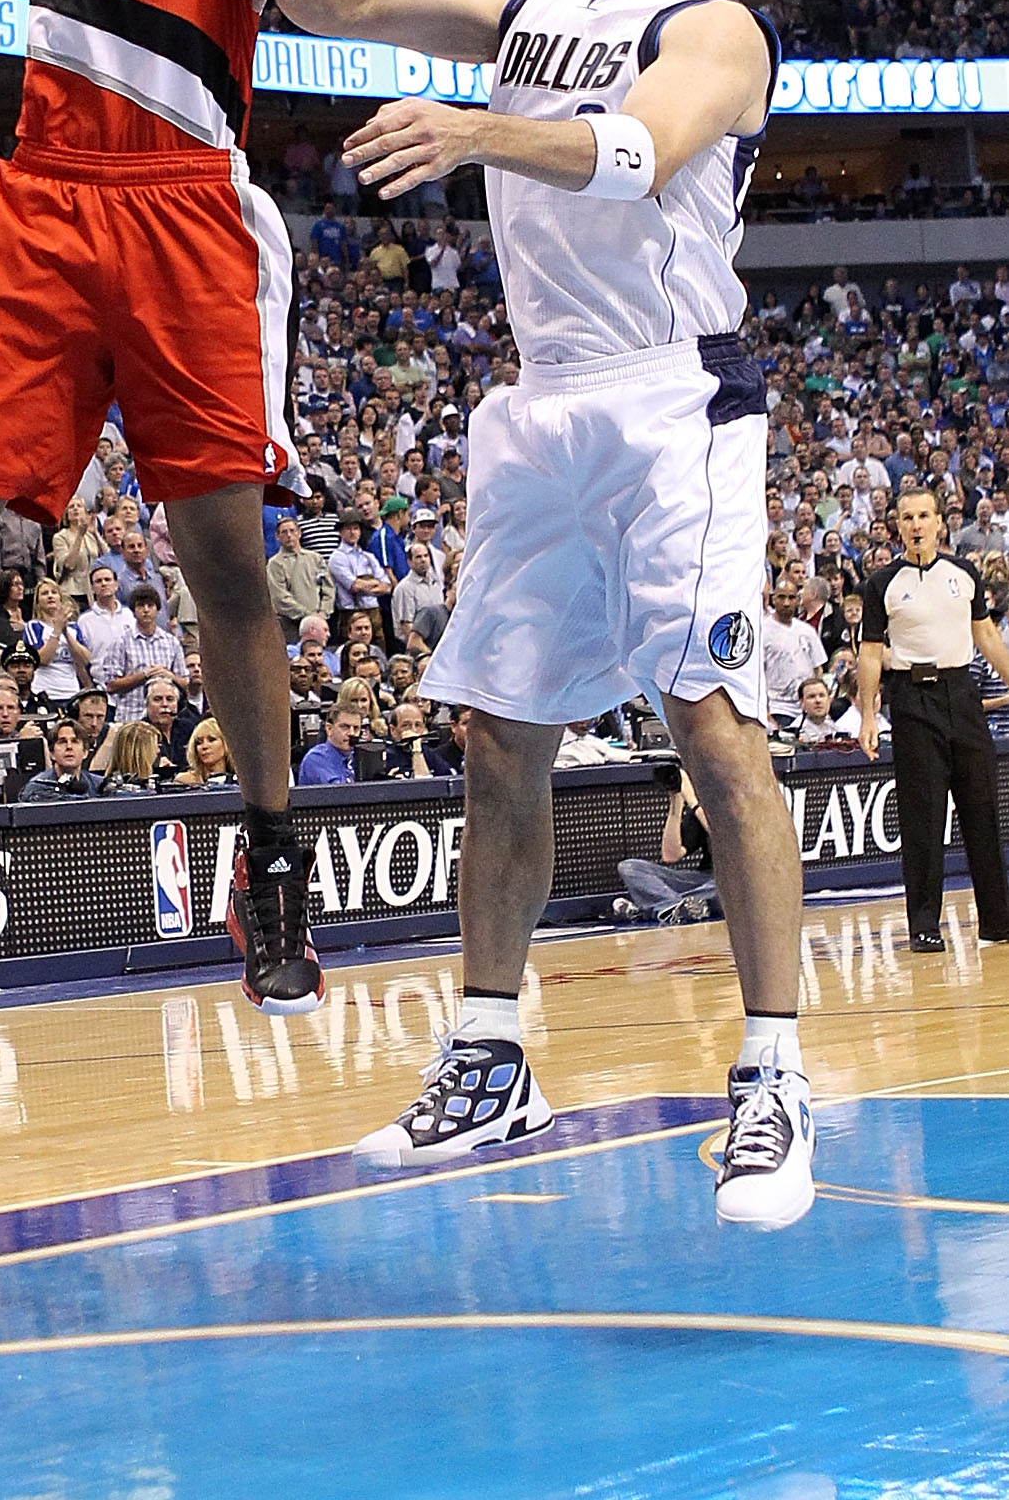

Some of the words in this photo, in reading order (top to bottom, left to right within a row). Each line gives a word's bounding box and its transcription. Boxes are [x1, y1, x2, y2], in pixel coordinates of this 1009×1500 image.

[255, 39, 368, 90] DALLAS
[499, 32, 633, 91] DALLAS
[614, 147, 642, 171] 2
[161, 911, 181, 930] NBA
